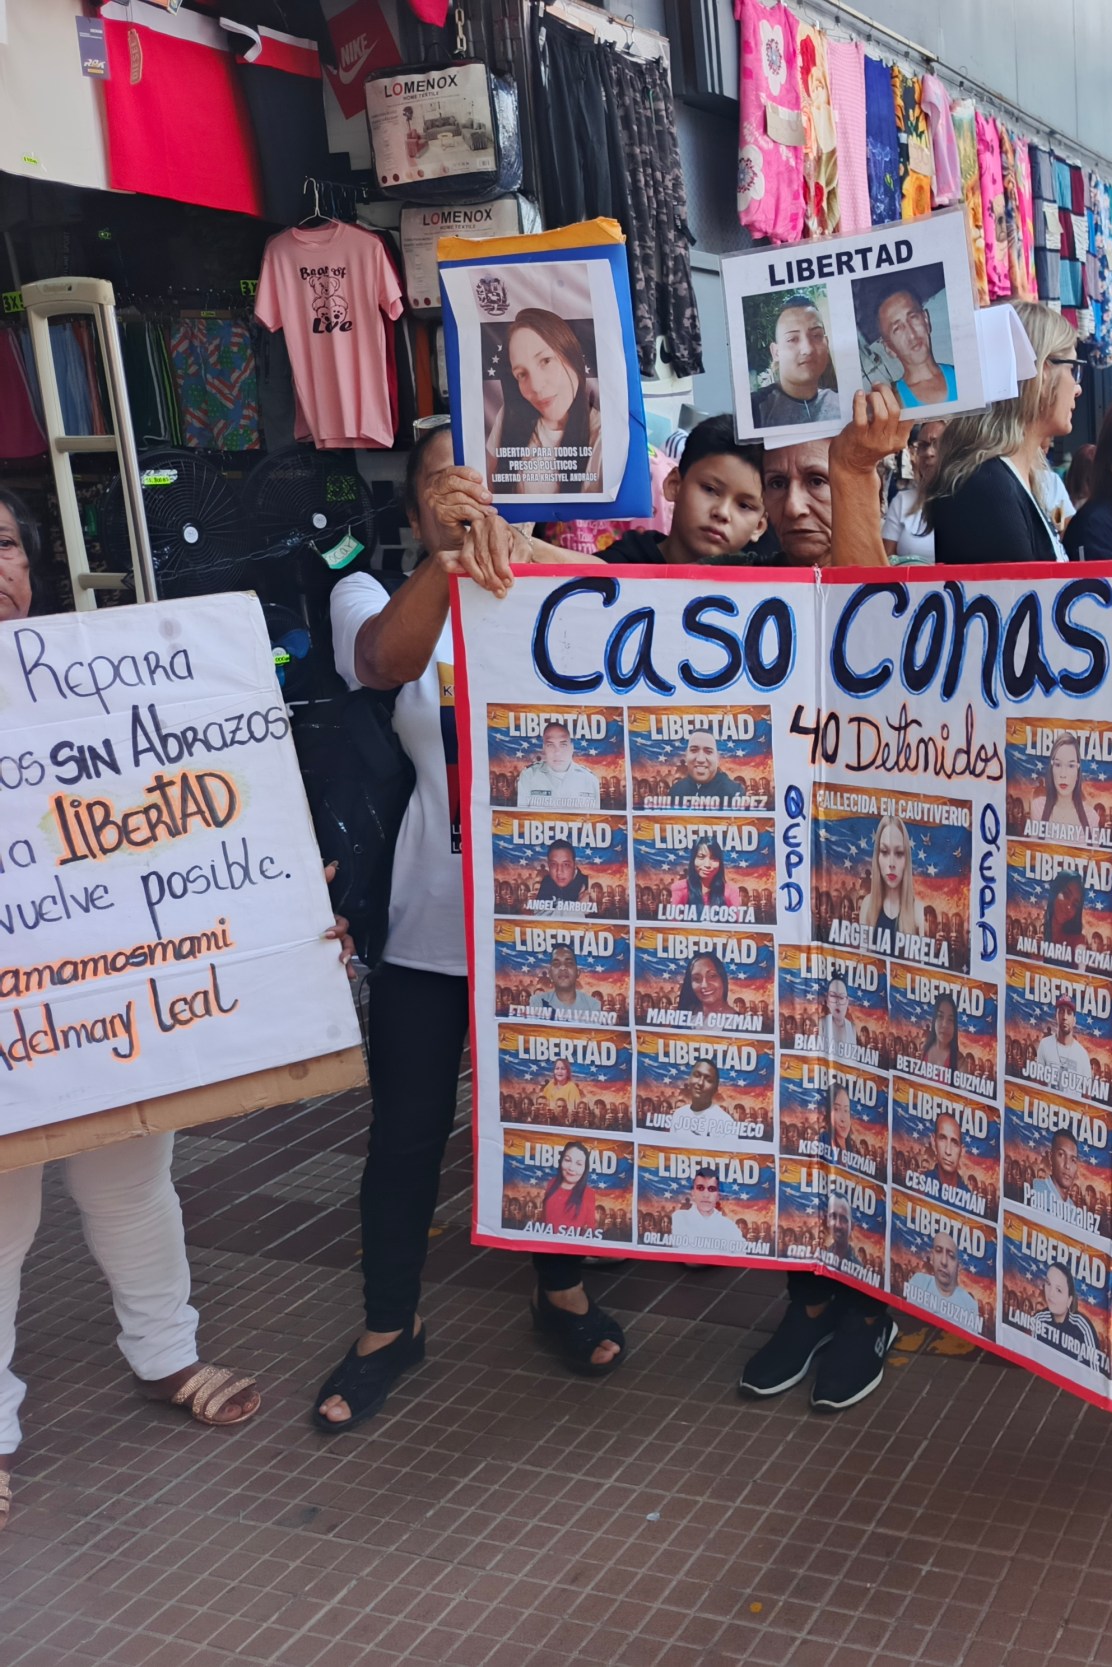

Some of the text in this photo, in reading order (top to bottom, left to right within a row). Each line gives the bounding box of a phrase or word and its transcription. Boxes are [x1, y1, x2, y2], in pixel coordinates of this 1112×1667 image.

[130, 40, 140, 79] DIESEL
[340, 33, 368, 67] NIKE
[384, 74, 458, 98] LOMENOX
[403, 91, 439, 100] HOME TEXTILE
[422, 208, 494, 226] LOMENOX
[768, 239, 913, 287] LIBERTAD
[495, 446, 593, 458] LIBERTAD PARA TODOS LOS
[509, 459, 538, 471] PRESOS
[492, 472, 521, 483] LIBERTAD
[522, 472, 541, 482] PARA
[569, 472, 598, 482] ANDRADE
[530, 576, 797, 697] Caso
[789, 703, 1004, 781] 40 Detenidos
[816, 790, 970, 827] FALLECIDA EN CAUTIVERIO
[1024, 819, 1112, 847] ADELMARY LEAL
[141, 837, 292, 940] posible.
[556, 900, 598, 913] BARBOZA
[658, 904, 756, 923] LUCIA ACOSTA
[828, 918, 949, 967] ARGELIA PIRELA
[1016, 936, 1038, 955] ANA
[554, 1007, 617, 1025] NAVARRO
[647, 1008, 763, 1032] MARIELA GUZMÁN
[517, 1035, 617, 1066] LIBERTAD
[896, 1055, 994, 1097] BETZABETH GUZMÁN
[1022, 1059, 1110, 1101] JORGE GUZMÁN
[646, 1113, 673, 1130] LUIS
[709, 1118, 764, 1138] PACHECO
[841, 1150, 876, 1176] GUZMÁN
[941, 1184, 986, 1216] GUZMÁN
[1023, 1181, 1100, 1236] Paul Gonzalez
[523, 1221, 603, 1241] ANA SALAS
[644, 1231, 688, 1247] ORLANDO
[840, 1258, 881, 1288] GUZMÁN
[939, 1295, 984, 1333] GUZMÁN
[1008, 1306, 1110, 1373] LANISBETH URDANETA
